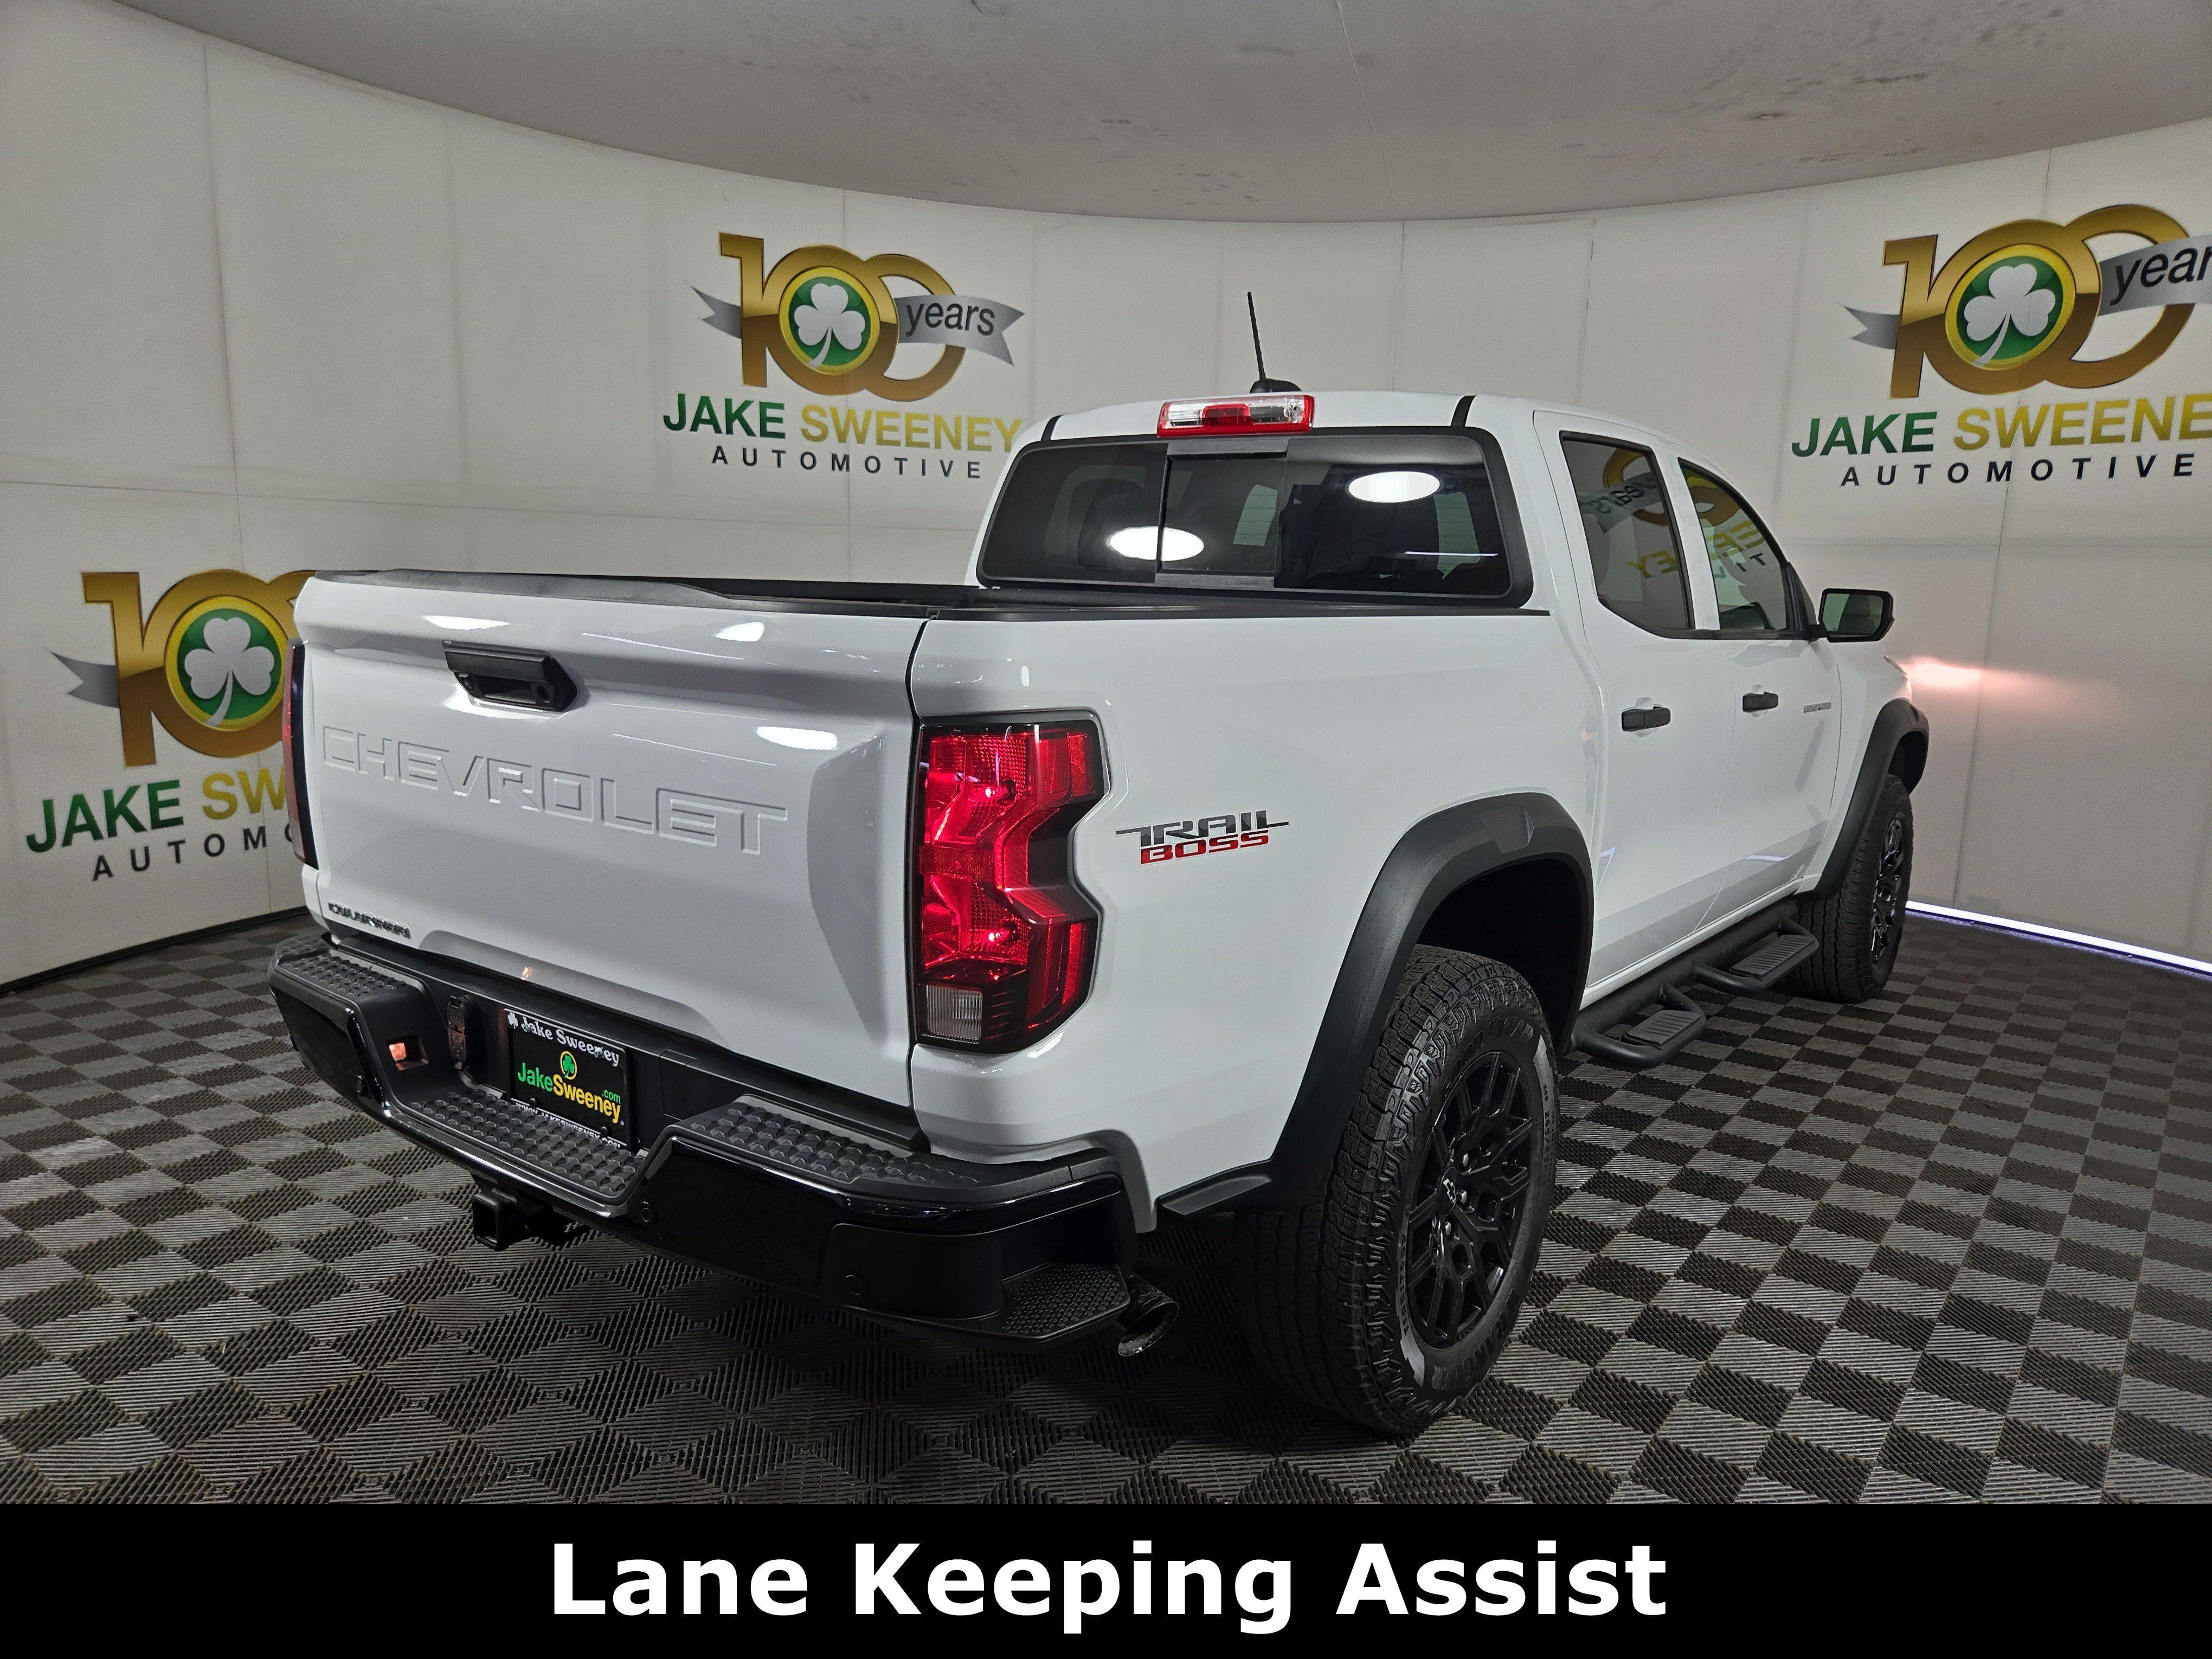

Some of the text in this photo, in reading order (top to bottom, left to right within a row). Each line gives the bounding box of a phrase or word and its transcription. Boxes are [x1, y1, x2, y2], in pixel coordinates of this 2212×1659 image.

[2110, 245, 2212, 306] year
[905, 303, 996, 337] years
[663, 393, 1023, 453] JAKE SWEENEY
[1791, 394, 2212, 458] JAKE SWEENE
[712, 445, 981, 480] AUTOMOTIVE
[1840, 453, 2195, 486] AUTOMOTIVE
[323, 725, 788, 856] CHEVROLET
[25, 779, 184, 853] JAKE
[1115, 809, 1290, 847] TRAIL
[92, 823, 292, 882] AUTOM
[1140, 829, 1269, 865] BOSS
[521, 1017, 554, 1040] Jake
[517, 1062, 621, 1124] JakeSweeney
[602, 1089, 621, 1104] .com
